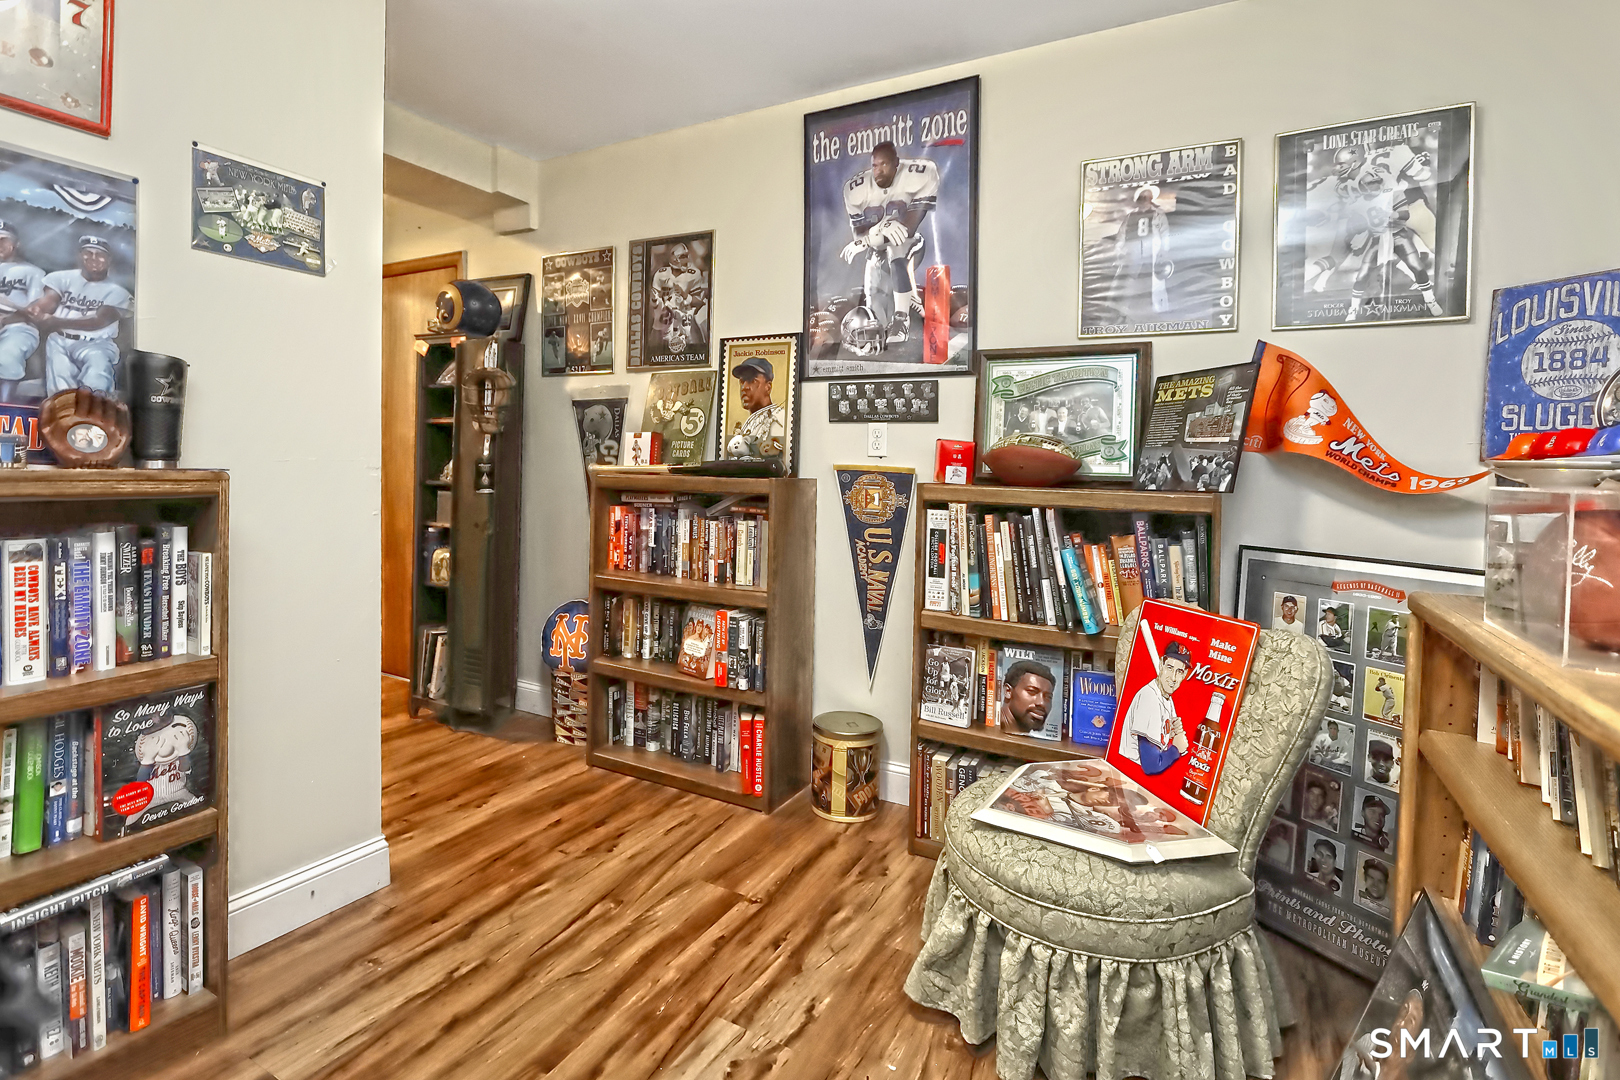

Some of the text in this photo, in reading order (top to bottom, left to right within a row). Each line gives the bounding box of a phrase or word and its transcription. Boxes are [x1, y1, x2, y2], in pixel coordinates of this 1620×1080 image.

[813, 109, 967, 163] the emmitt zone
[1323, 123, 1419, 150] LONE STAR GREATS
[229, 167, 248, 180] NEW
[250, 173, 276, 188] YORK
[1085, 146, 1214, 186] STRONG ARM
[1120, 173, 1212, 188] THE LAW
[555, 251, 600, 268] COWBOYS
[630, 244, 643, 366] DALLAS COWBOYS
[1083, 320, 1209, 335] TROY AIKMAN
[1554, 323, 1593, 335] Since
[651, 354, 685, 362] AMERICA'S
[755, 349, 786, 357] Robinson
[1533, 346, 1610, 373] 1884
[1016, 373, 1051, 393] CELTIC
[1053, 367, 1109, 385] TRADITION
[1159, 375, 1215, 390] THE AMAZING
[1155, 385, 1215, 402] METS
[671, 441, 694, 449] PICTURE
[1343, 418, 1387, 461] NEW YORK
[1325, 450, 1397, 488] WORLD CHAMPS
[1329, 435, 1401, 482] Mets
[1409, 476, 1470, 490] 1969
[176, 550, 185, 562] THE
[1136, 521, 1150, 568] BALLPARKS
[73, 560, 91, 583] THE
[119, 542, 131, 575] SWITZER
[161, 544, 171, 575] Breaking
[1158, 544, 1167, 584] BALLPARK
[14, 566, 26, 587] BEEN
[28, 565, 39, 603] COWBOYS
[54, 562, 67, 601] TEX!
[143, 569, 152, 597] TEXAS
[162, 576, 170, 591] Free
[175, 563, 186, 586] BOYS
[866, 568, 890, 613] NAVAL
[1368, 584, 1394, 597] BASEBALL
[73, 586, 91, 632] EMMITT
[177, 600, 185, 610] Skip
[15, 605, 26, 638] HEROES
[1154, 622, 1188, 638] Ted Williams
[73, 633, 91, 665] ZONE
[1003, 647, 1035, 660] WILT
[1208, 650, 1233, 664] Mine
[1210, 638, 1237, 652] Make
[927, 658, 939, 667] Go
[927, 667, 938, 676] Up
[925, 677, 938, 685] for
[1187, 662, 1240, 690] MOXIE
[925, 686, 947, 698] Glory
[113, 691, 205, 723] So Many Ways
[924, 705, 965, 720] Bill Russell
[108, 720, 153, 738] to Lose
[53, 733, 65, 778] HODGES
[70, 741, 79, 777] Backstage
[72, 778, 78, 786] at
[935, 765, 943, 802] WOODEN
[141, 809, 168, 825] Devin
[170, 795, 205, 813] Gordon
[11, 884, 110, 931] INSIGHT PITCH
[1256, 879, 1301, 912] Prints
[1302, 905, 1336, 927] and
[139, 898, 147, 956] DAVID WRIGHT
[168, 907, 180, 955] Kings Queens
[1268, 901, 1282, 916] THE
[1286, 909, 1348, 949] METROPOLITAN
[92, 913, 102, 985] NEW YORK METS
[1511, 939, 1532, 961] HISTORY
[70, 947, 84, 983] MOOKIE
[1513, 979, 1568, 1004] Grandest
